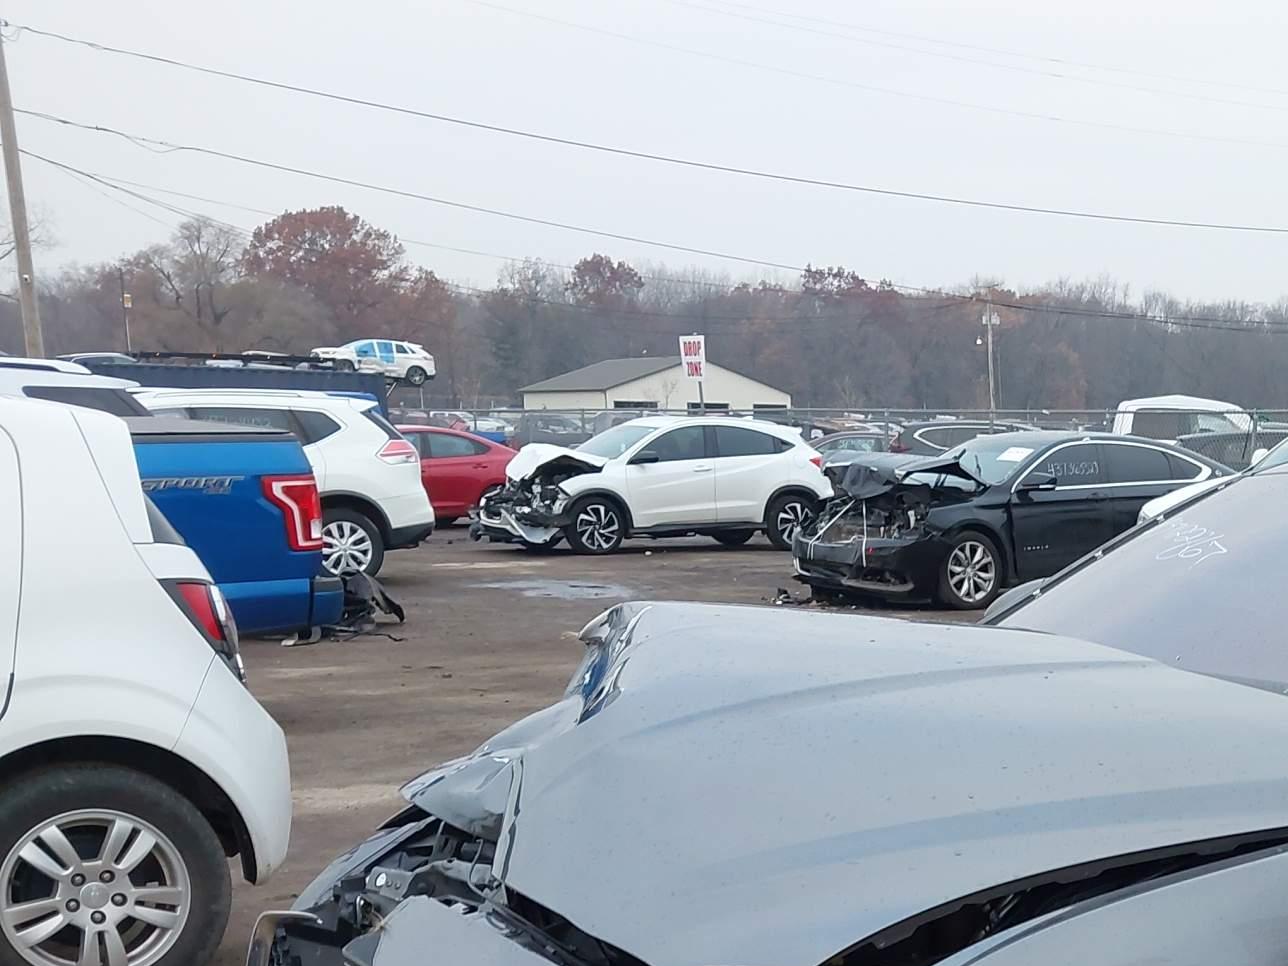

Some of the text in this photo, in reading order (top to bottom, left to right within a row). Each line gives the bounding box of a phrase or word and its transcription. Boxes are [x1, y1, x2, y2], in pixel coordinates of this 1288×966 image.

[683, 340, 702, 357] DROP
[686, 361, 703, 377] ZONE
[141, 475, 246, 491] SPORT
